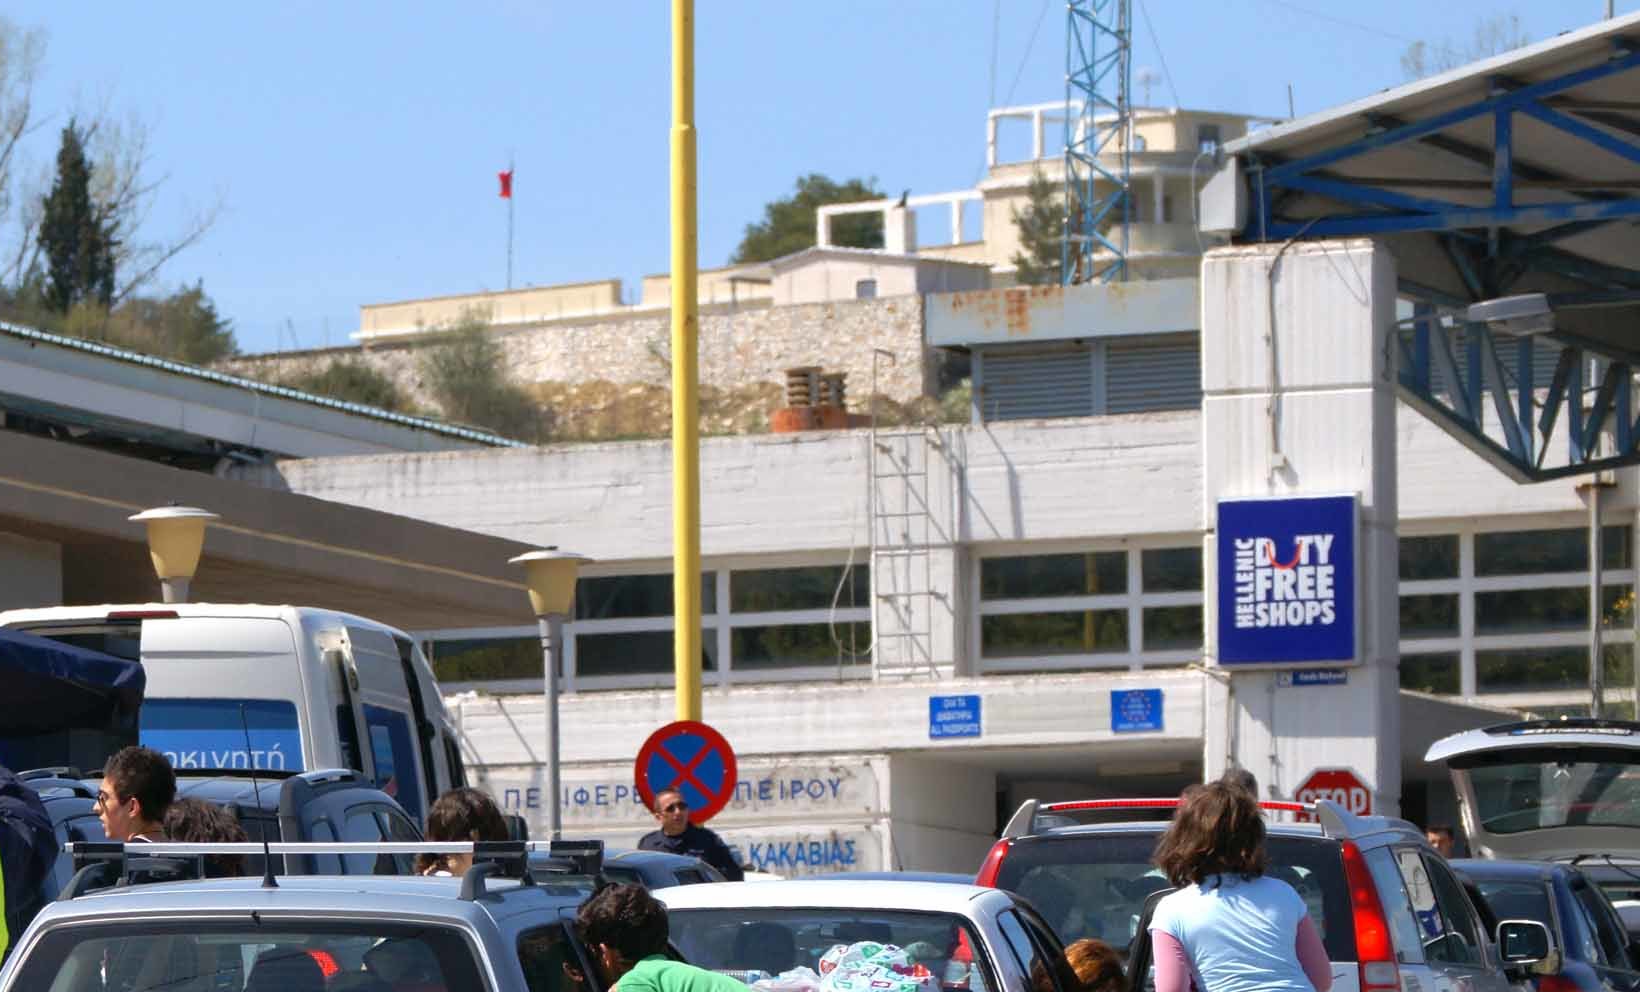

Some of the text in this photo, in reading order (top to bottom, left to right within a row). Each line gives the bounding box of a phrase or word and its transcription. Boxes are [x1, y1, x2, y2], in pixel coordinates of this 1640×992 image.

[1234, 537, 1256, 629] HELLENIC
[1255, 565, 1336, 602] FREE
[1255, 600, 1336, 628] SHOPS
[736, 779, 842, 801] ΠΕΙΡΟΥ
